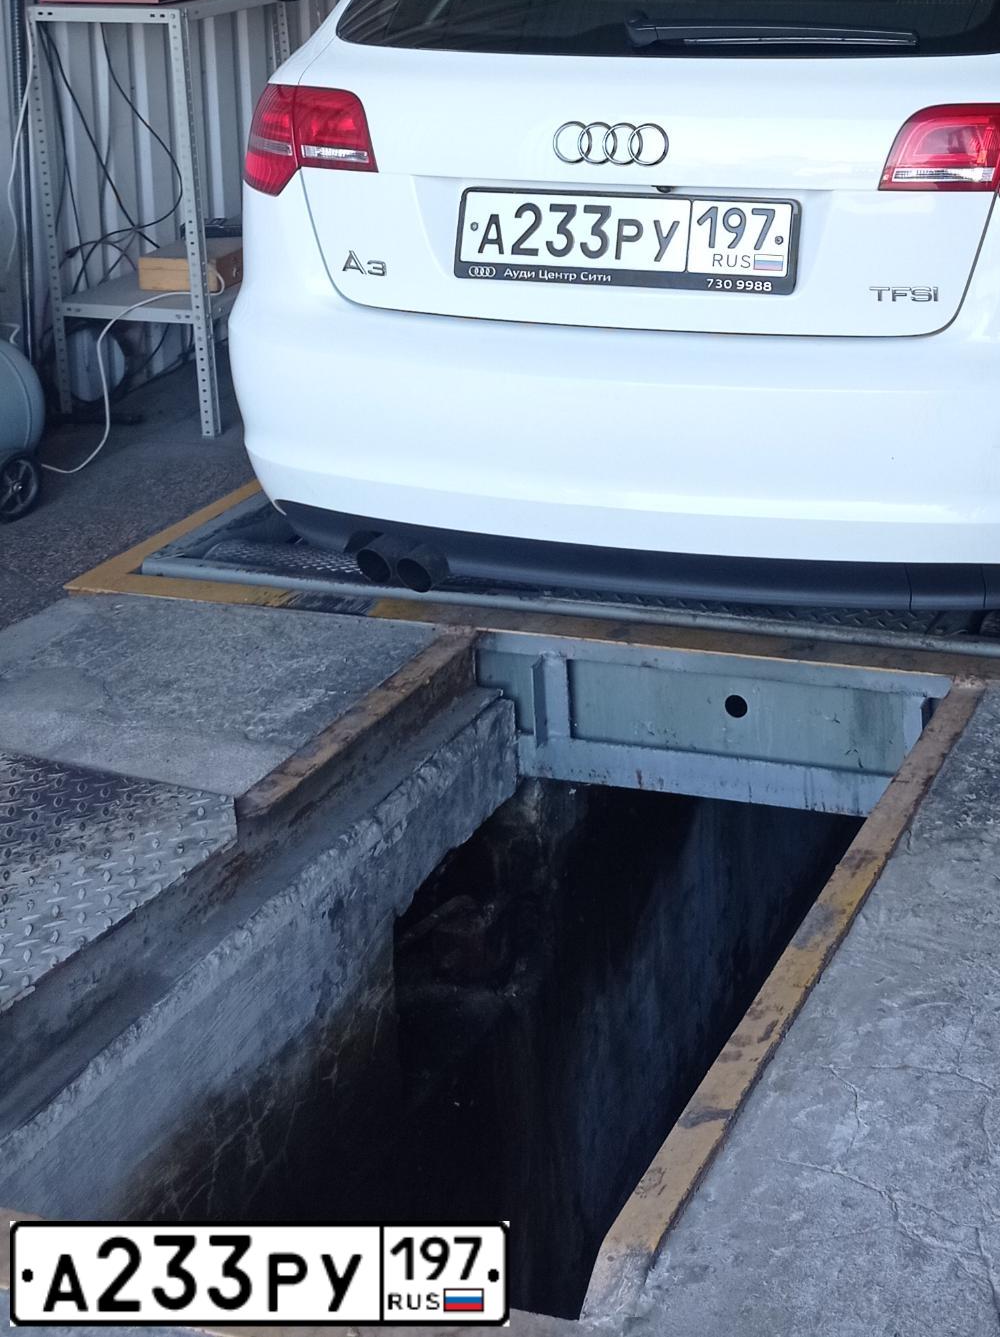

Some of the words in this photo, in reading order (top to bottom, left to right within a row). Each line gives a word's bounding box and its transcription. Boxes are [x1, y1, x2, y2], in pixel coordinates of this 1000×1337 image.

[697, 206, 775, 250] 197
[342, 250, 387, 276] A3
[712, 253, 751, 268] RUS
[504, 268, 535, 279] Ауди
[539, 270, 577, 281] Центр
[580, 271, 612, 282] Сити
[706, 278, 732, 289] 730
[736, 280, 772, 291] 9988
[869, 287, 938, 302] TFSI
